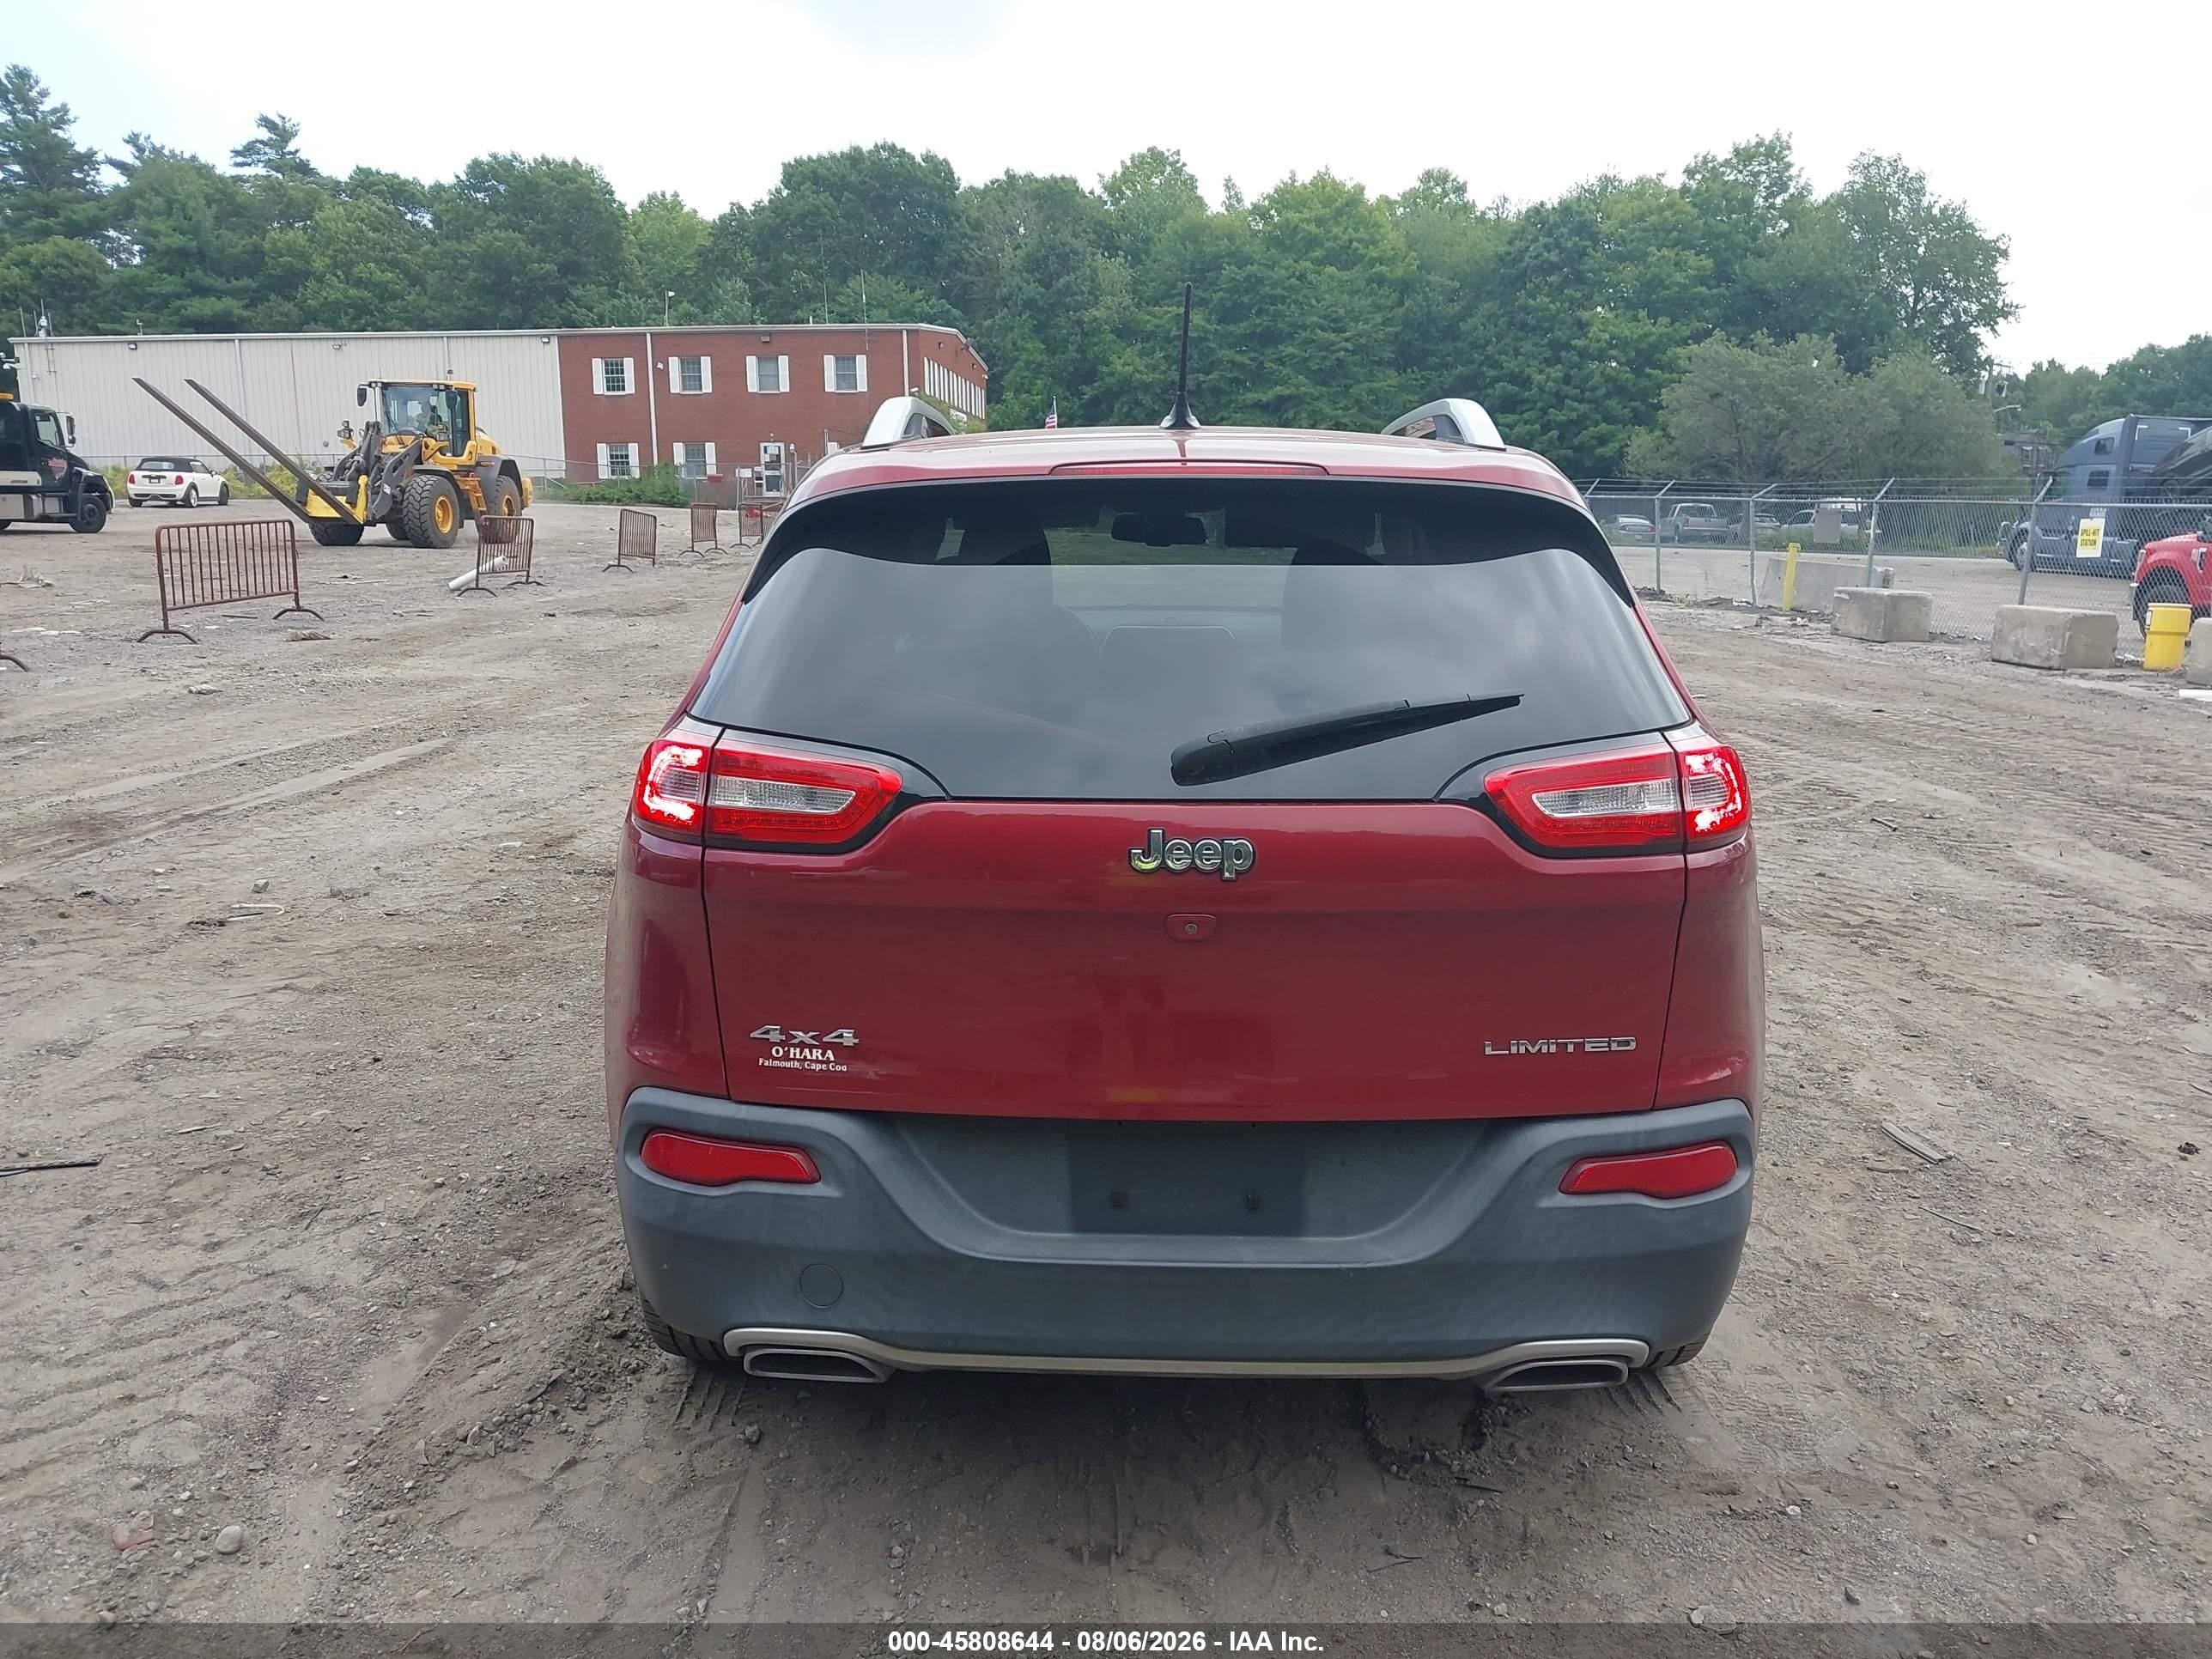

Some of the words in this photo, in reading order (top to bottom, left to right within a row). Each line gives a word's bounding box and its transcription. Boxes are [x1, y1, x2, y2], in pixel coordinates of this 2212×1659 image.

[2081, 538, 2097, 547] STATION
[1129, 829, 1255, 880] Jeep
[750, 1024, 860, 1047] 4x4
[771, 1046, 835, 1061] O'HARA
[1484, 1036, 1637, 1055] LIMITED
[758, 1058, 803, 1070] Falmouth,
[805, 1061, 827, 1072] Cape
